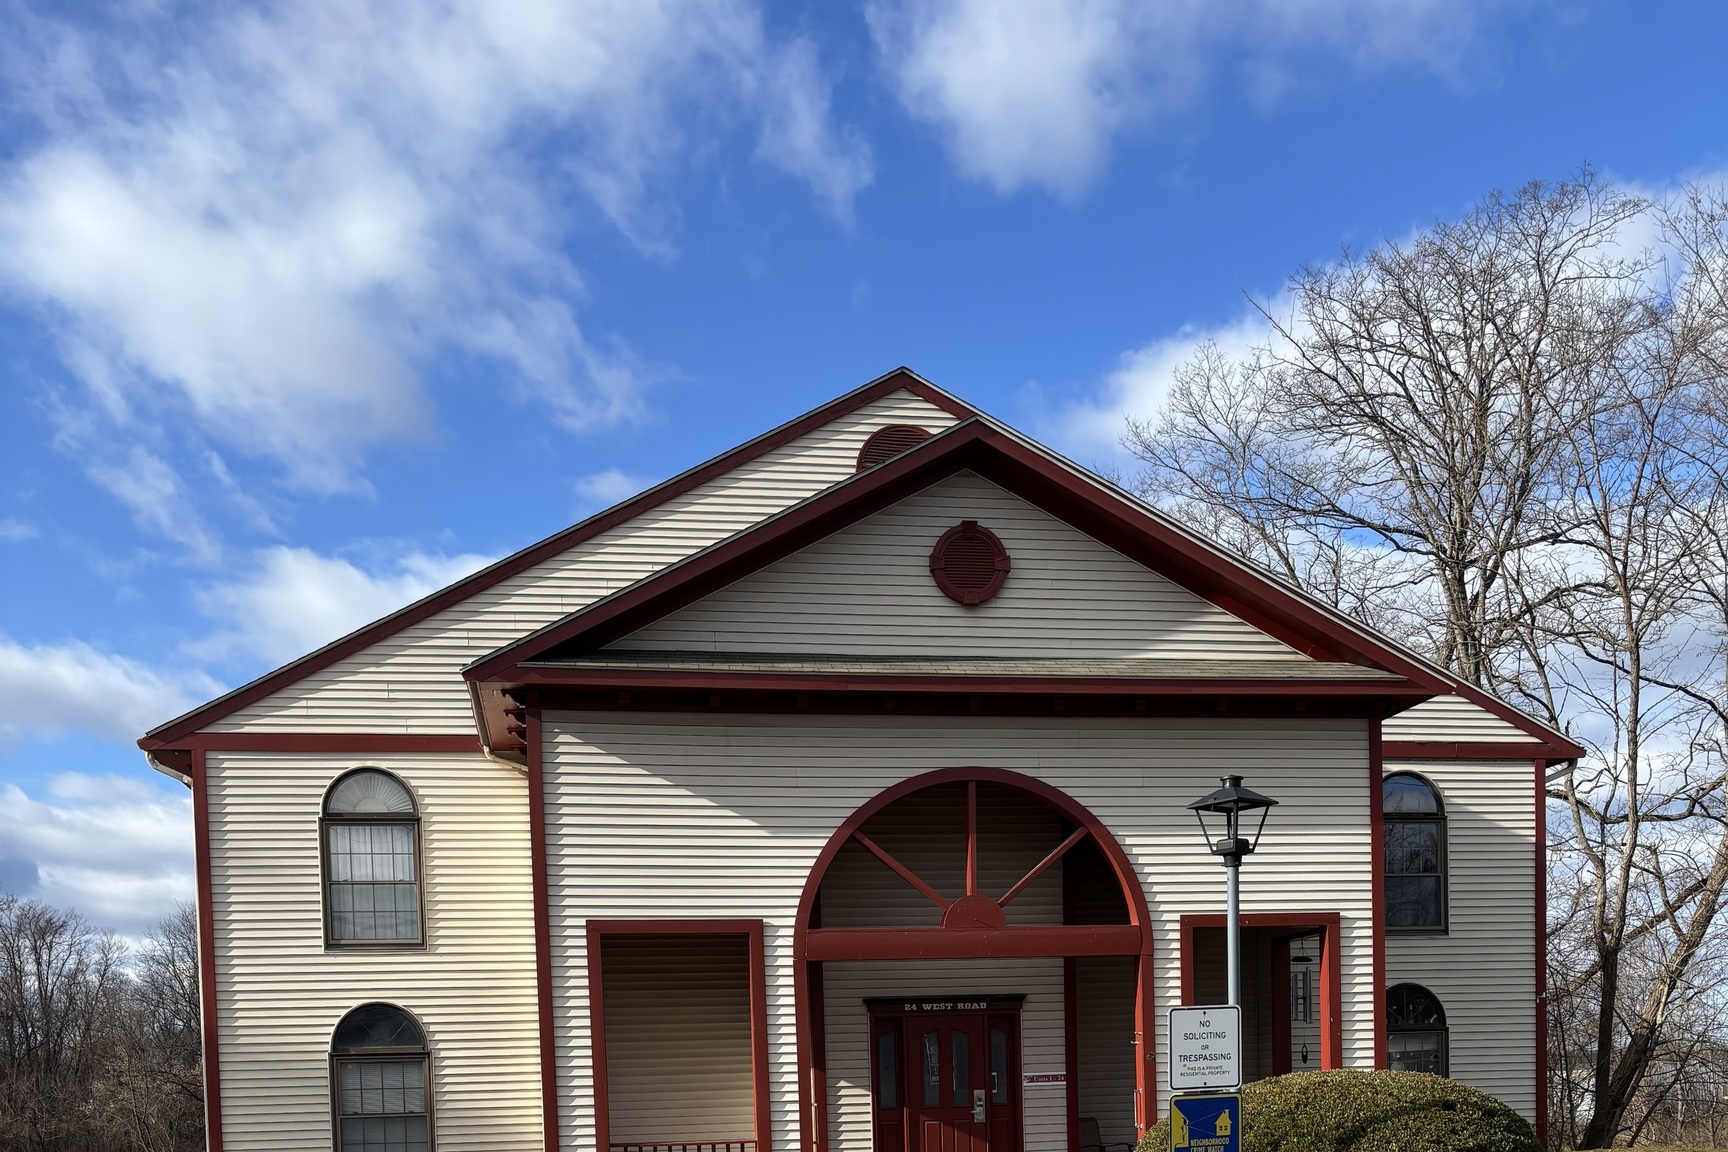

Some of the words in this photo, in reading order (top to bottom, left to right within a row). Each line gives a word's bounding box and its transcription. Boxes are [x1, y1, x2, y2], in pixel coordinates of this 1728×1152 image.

[957, 1002, 988, 1010] ROAD
[1199, 1020, 1211, 1028] NO
[1183, 1031, 1227, 1040] SOLICITING
[1178, 1052, 1232, 1062] TRESPASSING
[1190, 1137, 1230, 1146] NEIGHBORHOOD
